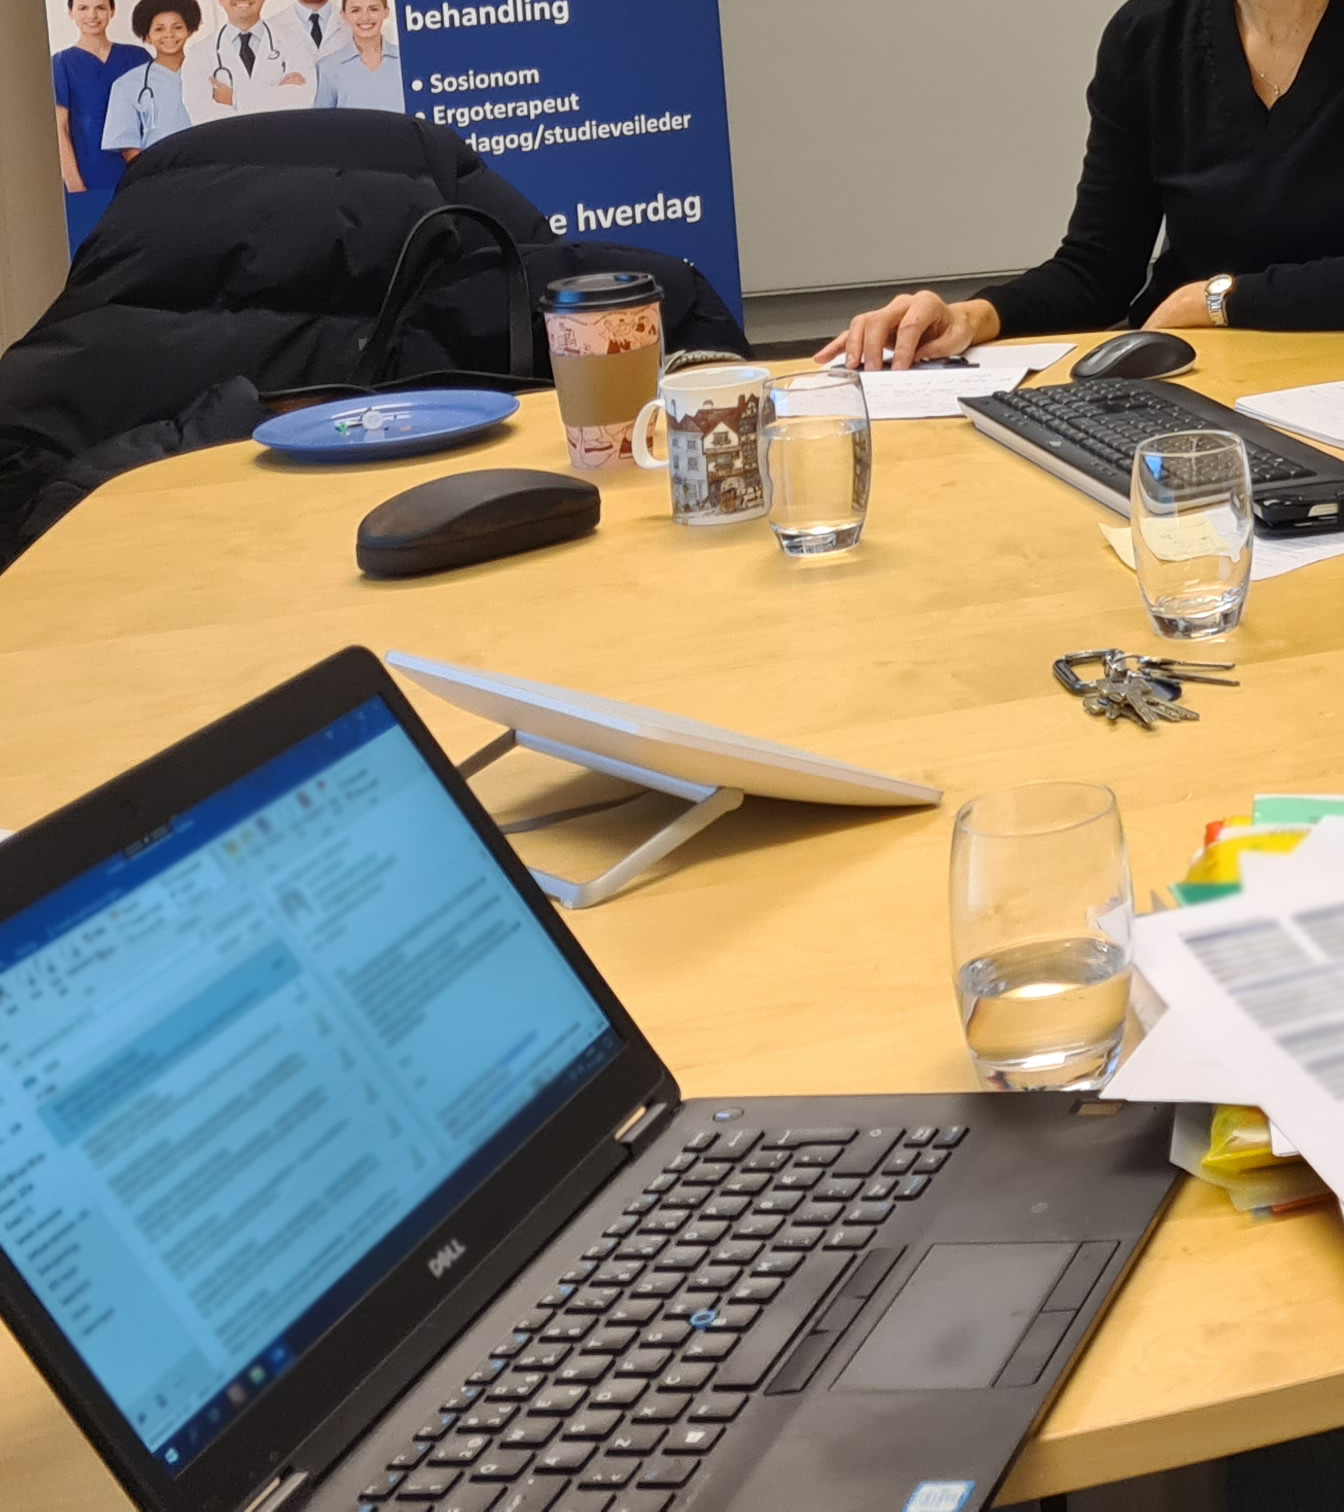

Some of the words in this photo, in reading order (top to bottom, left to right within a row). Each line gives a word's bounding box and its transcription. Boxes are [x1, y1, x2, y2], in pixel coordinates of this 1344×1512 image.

[429, 68, 540, 94] Sosionom
[433, 93, 580, 128] Ergoterapeut
[465, 111, 692, 155] dagog/studieveileder
[576, 192, 702, 232] hverdag
